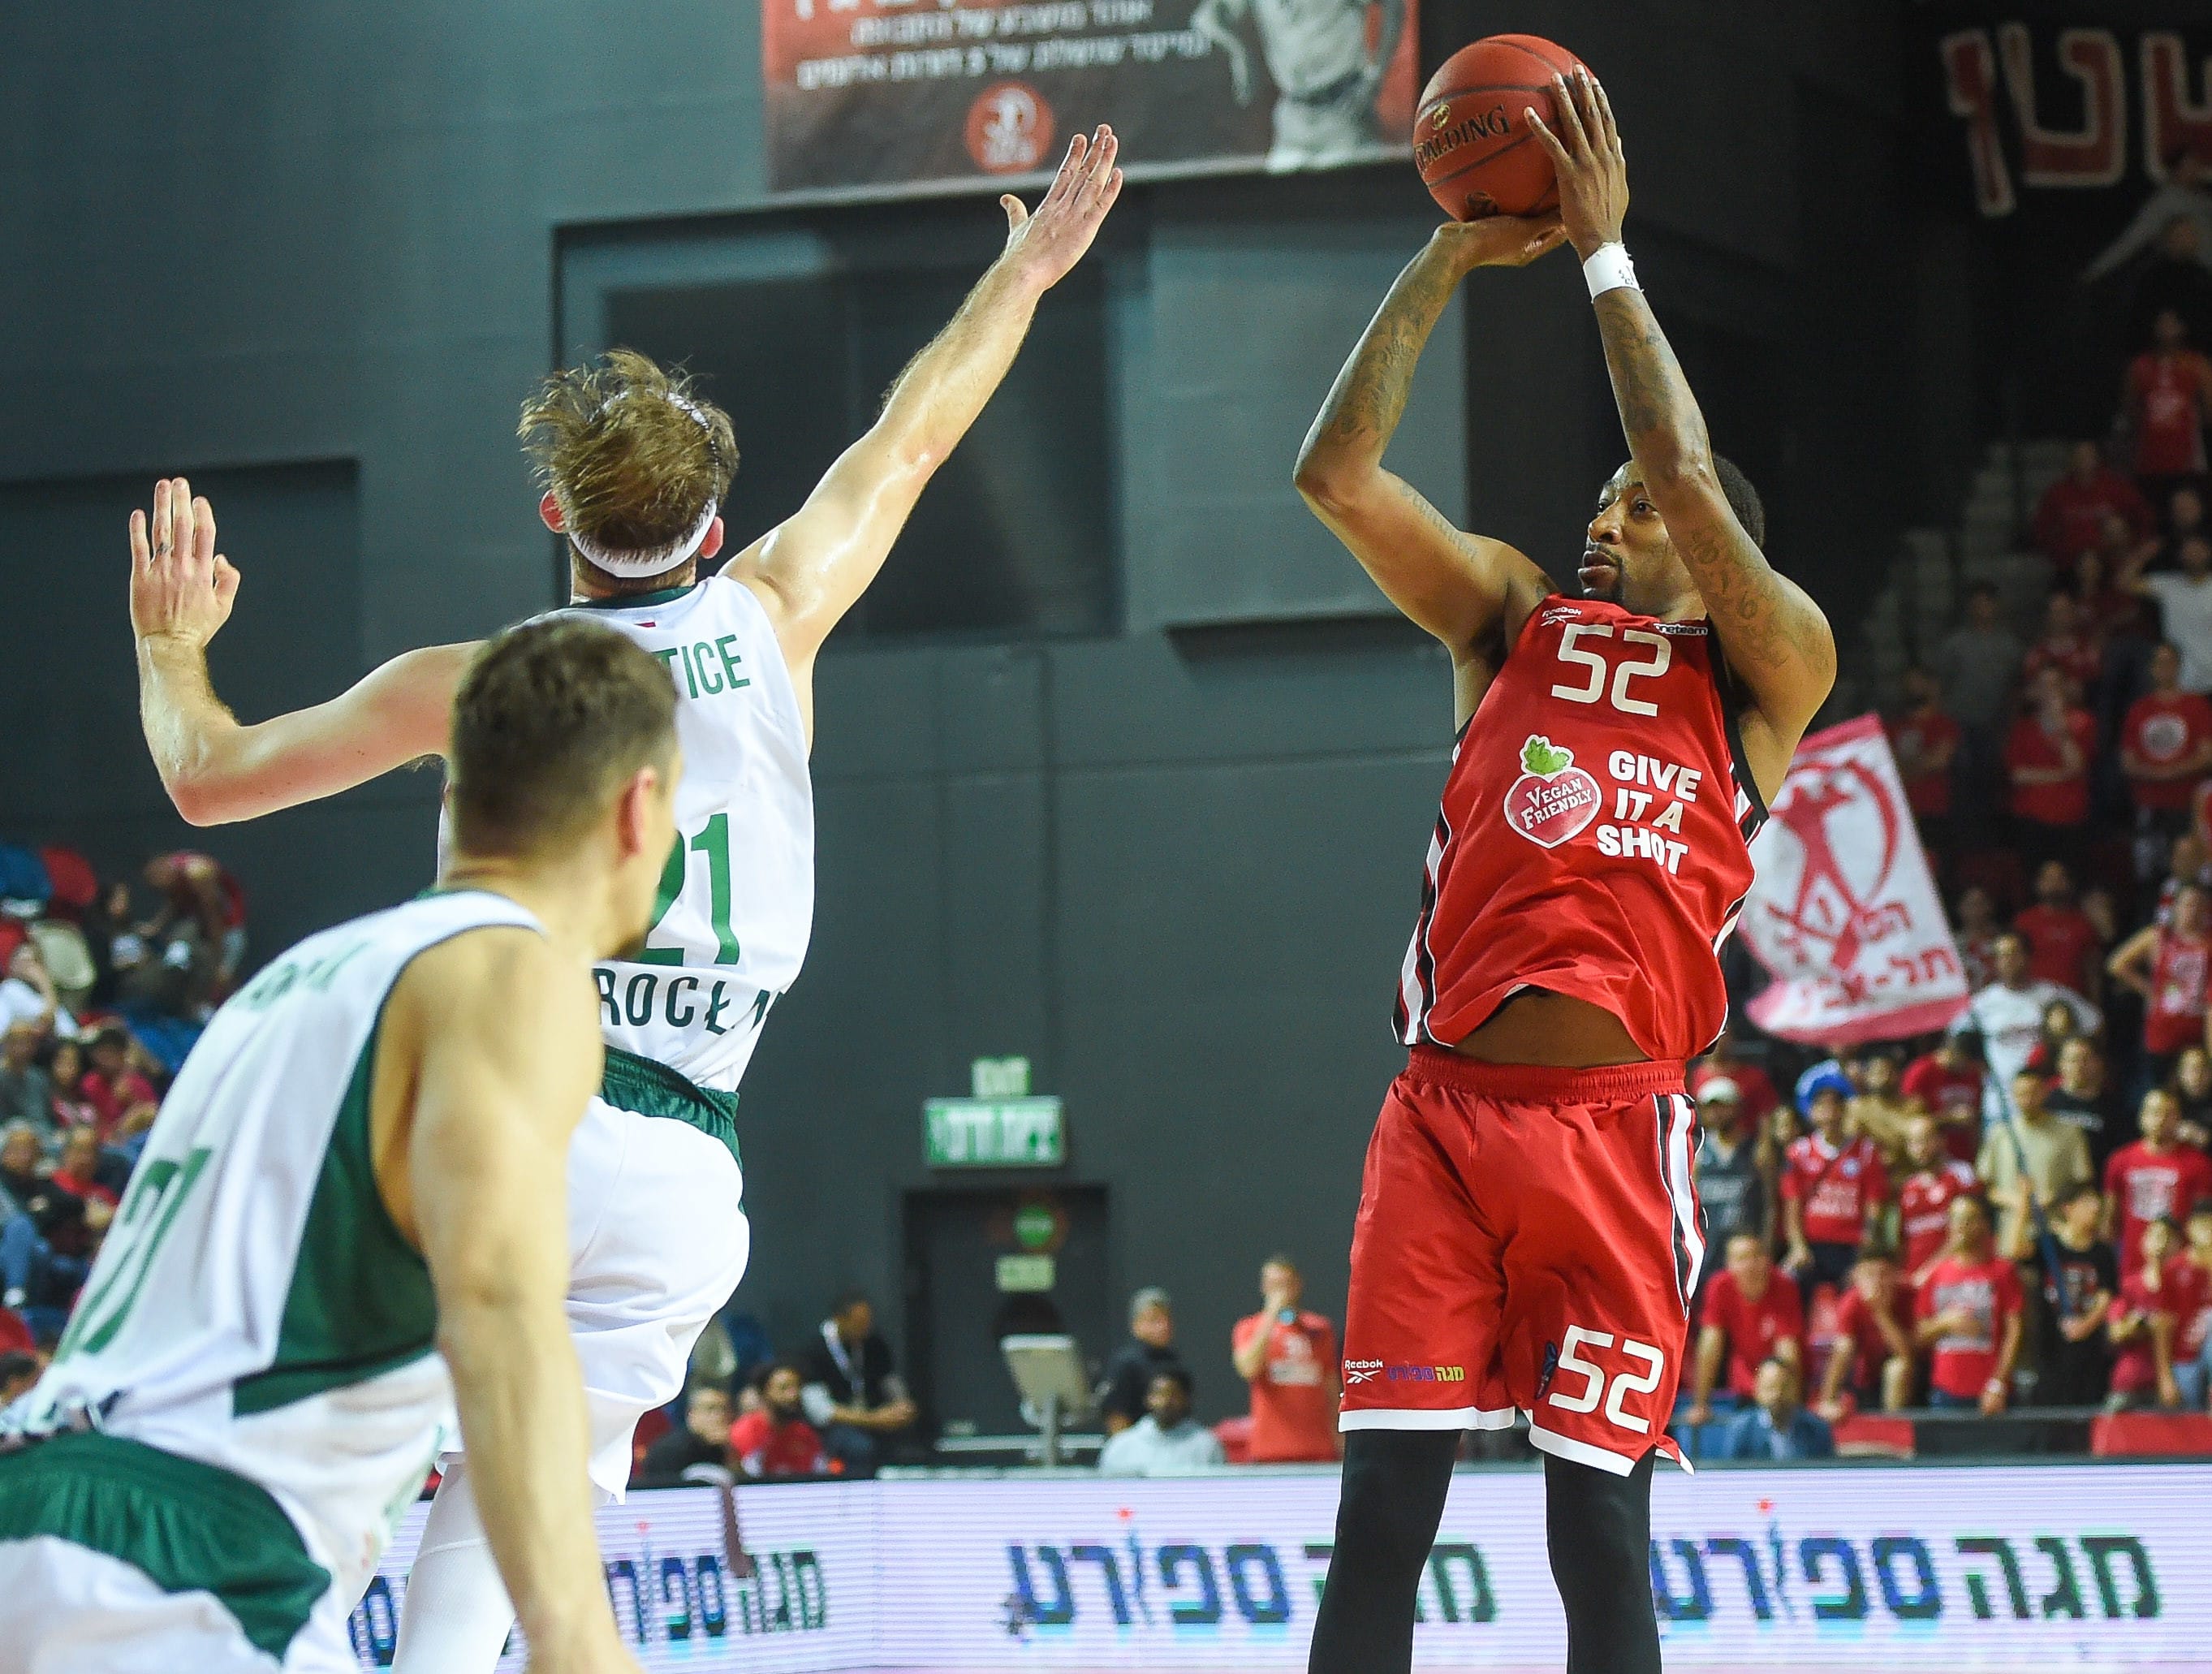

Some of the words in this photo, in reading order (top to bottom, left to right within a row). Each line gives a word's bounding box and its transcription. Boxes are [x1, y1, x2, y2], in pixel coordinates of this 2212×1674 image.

[1551, 623, 1671, 718] 52
[1520, 788, 1593, 830] FRIENDLY
[1526, 778, 1584, 808] VEGAN
[1608, 750, 1702, 802] GIVE
[1614, 788, 1653, 822] IT
[1652, 800, 1684, 835] A
[1596, 823, 1689, 875] SHOT
[1344, 1359, 1383, 1370] Reebok
[1549, 1323, 1665, 1435] 52
[602, 1534, 726, 1642] ספור
[1010, 1528, 1292, 1624] ספורט
[1650, 1525, 1943, 1620] ספורט
[1955, 1536, 2163, 1620] מגה
